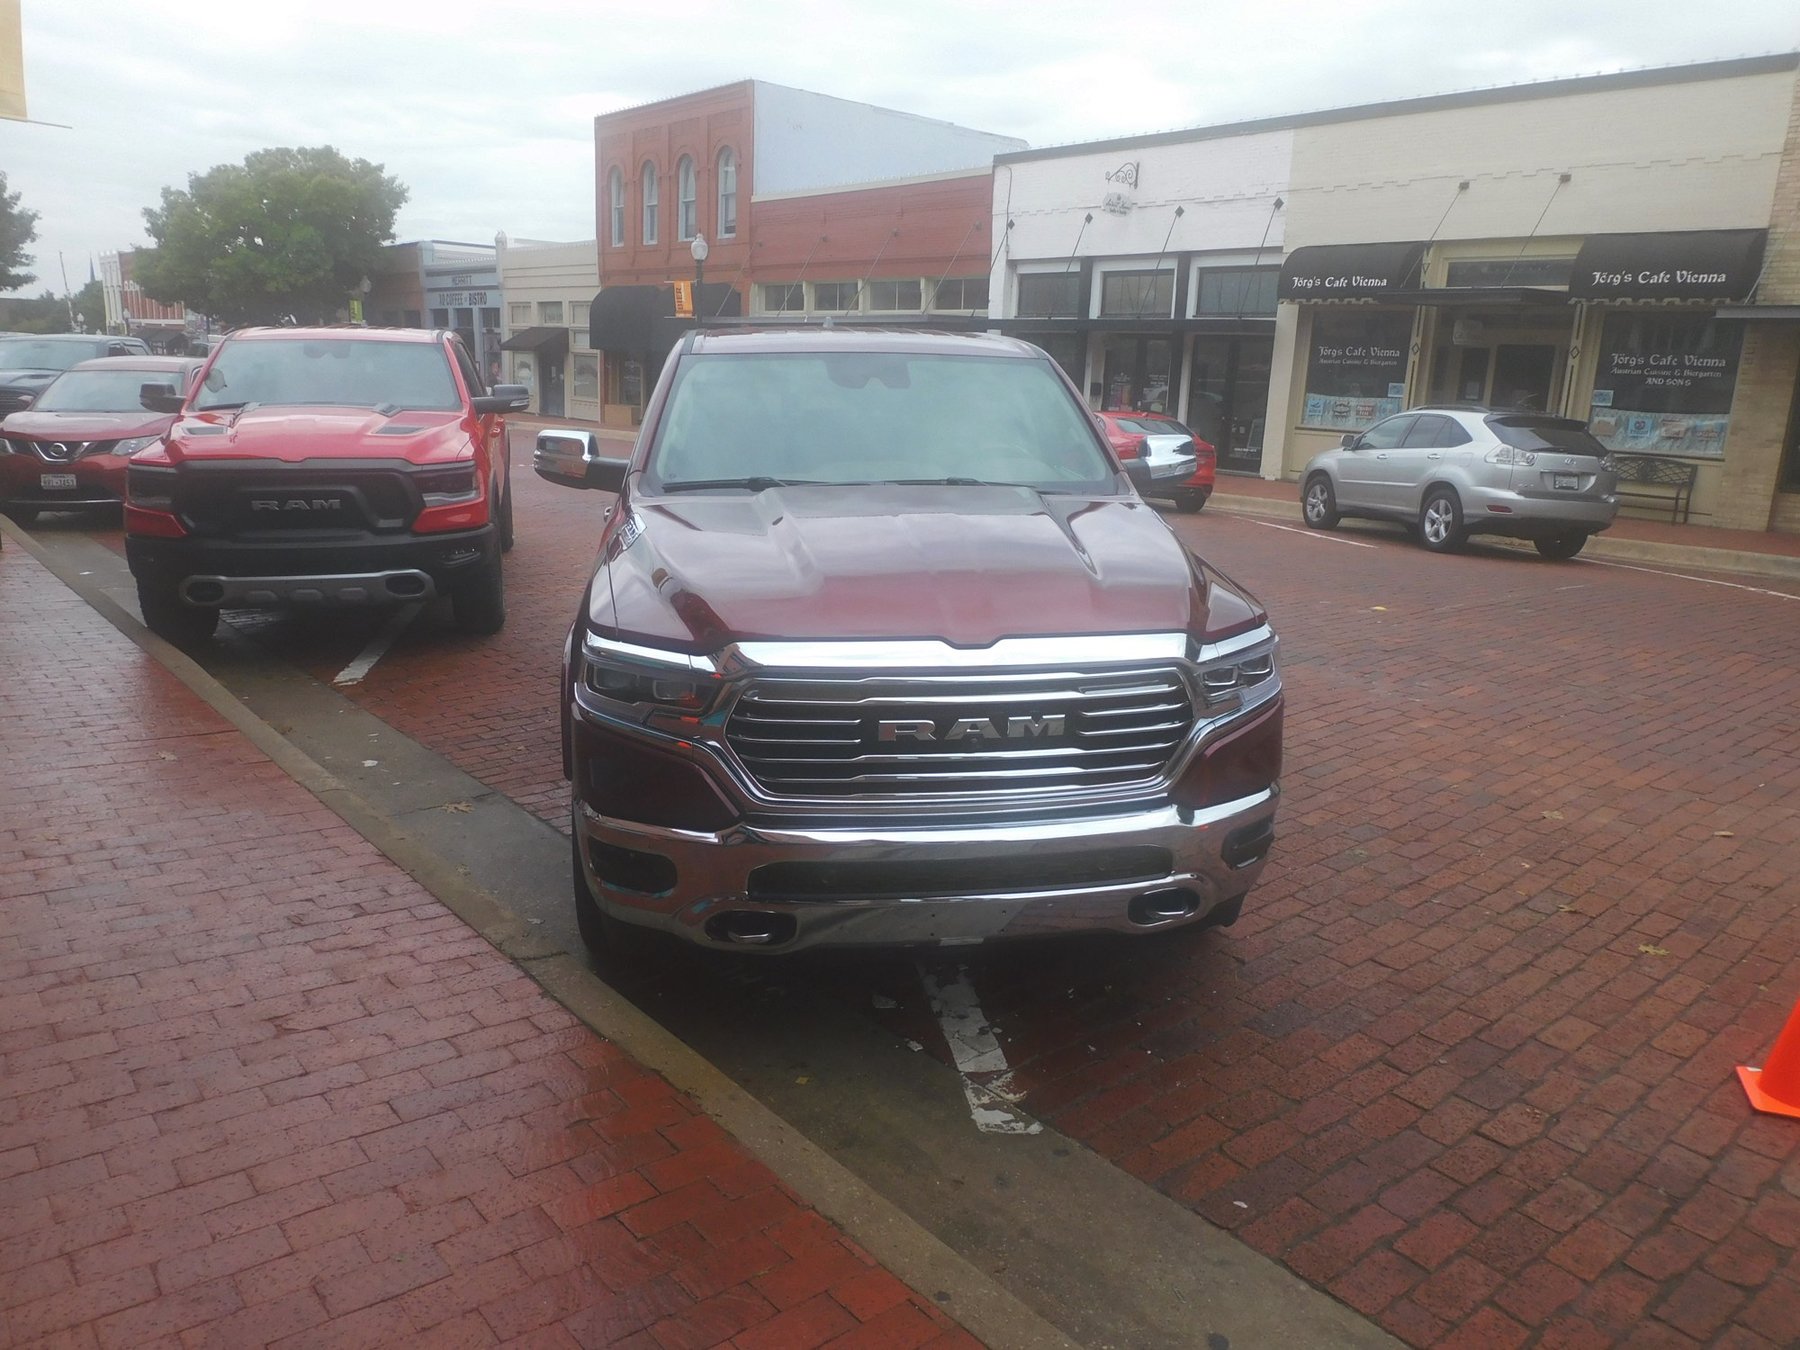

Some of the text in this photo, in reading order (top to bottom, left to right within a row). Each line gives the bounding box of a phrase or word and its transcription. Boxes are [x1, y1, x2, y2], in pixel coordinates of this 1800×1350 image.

[1292, 275, 1387, 289] Jörg's Cafe Vienna
[1591, 269, 1727, 286] Jörg's Cafe Vienna
[446, 292, 464, 306] COFFEE
[468, 291, 488, 306] BISTRO
[1345, 346, 1366, 356] Cafe
[1370, 346, 1400, 357] Vienna
[1610, 353, 1726, 367] Jörg's Cafe Vienna
[251, 499, 341, 511] RAM
[878, 714, 1066, 741] RAM
